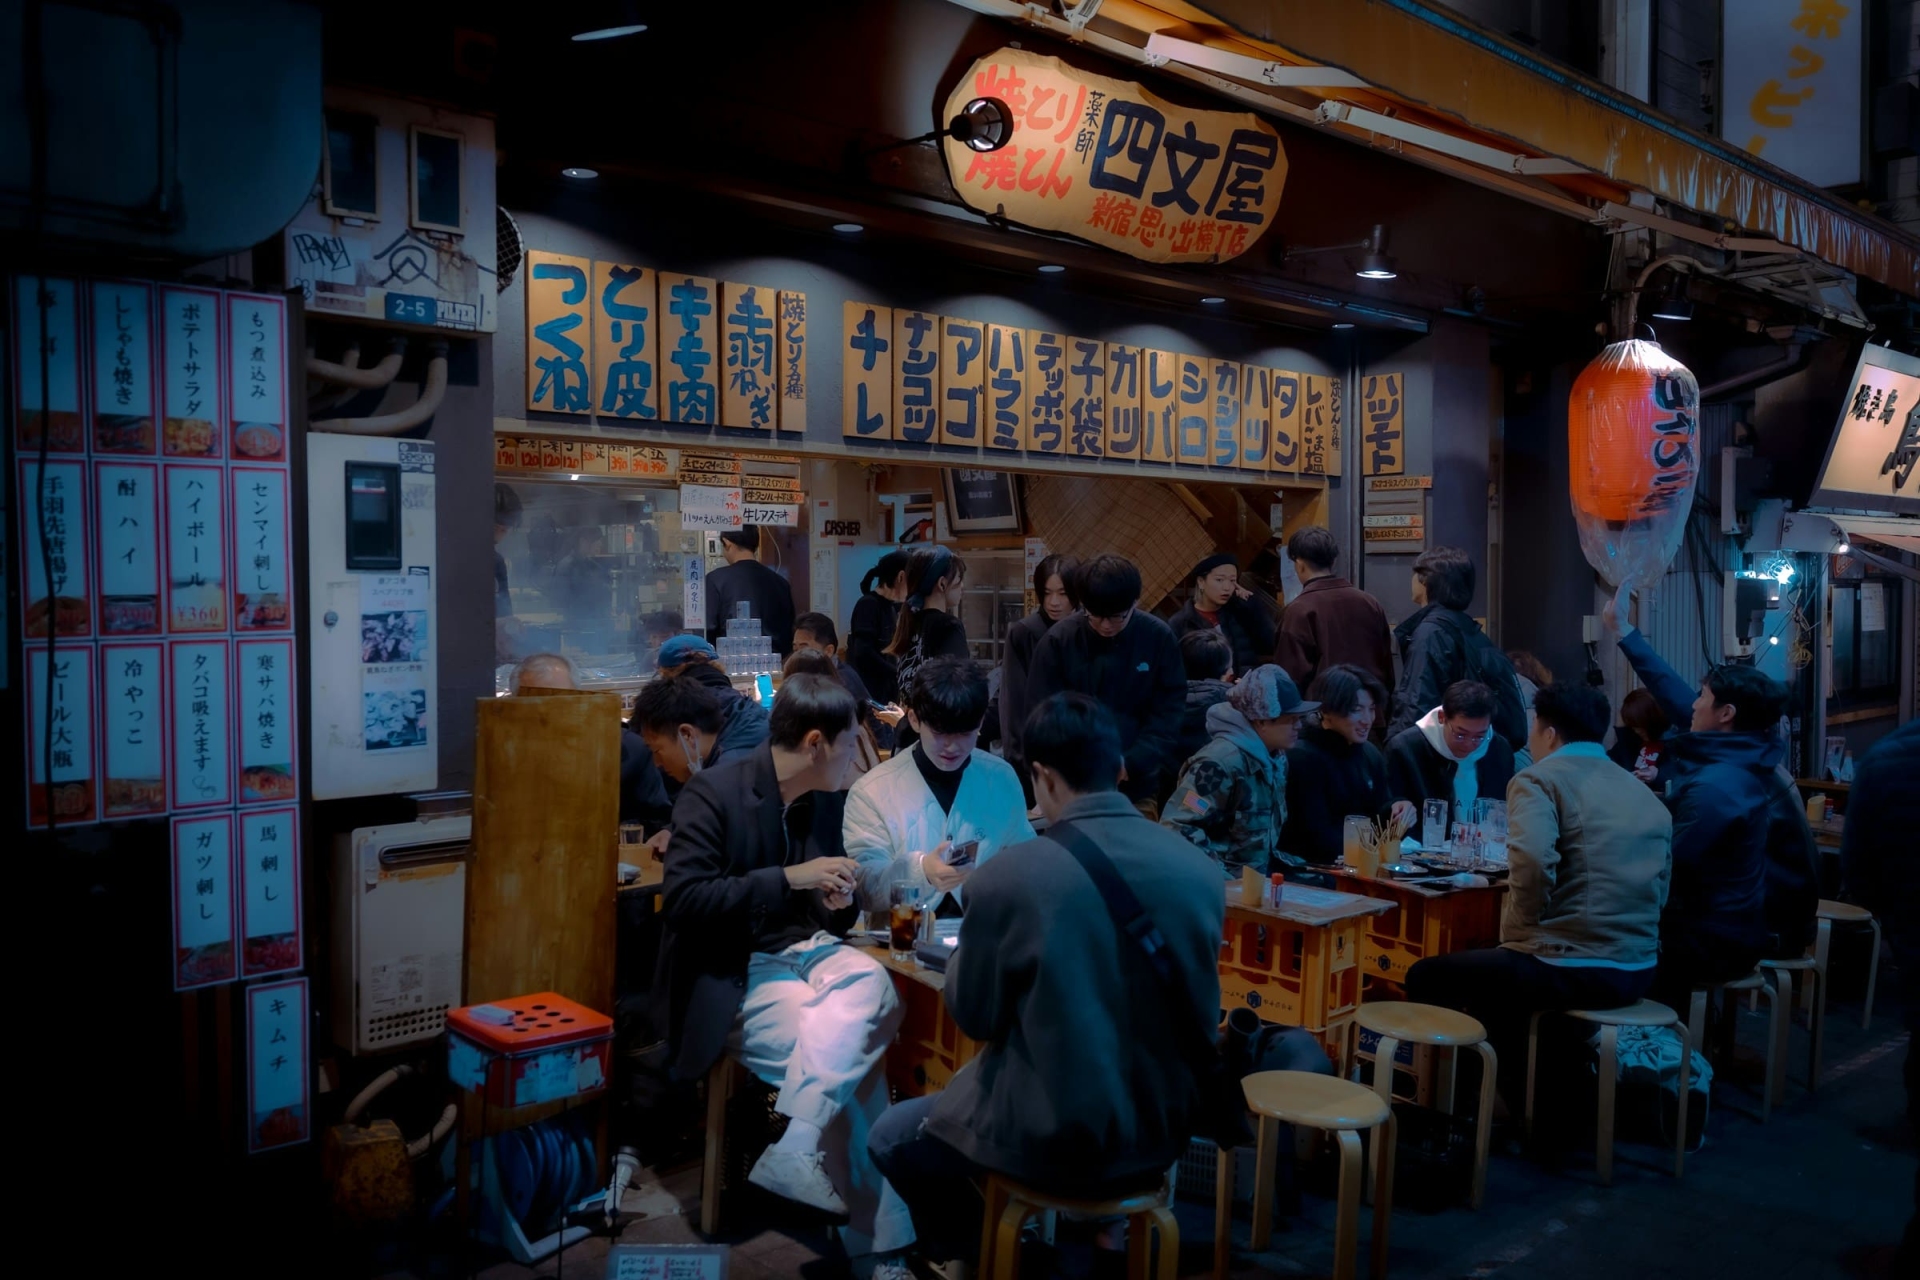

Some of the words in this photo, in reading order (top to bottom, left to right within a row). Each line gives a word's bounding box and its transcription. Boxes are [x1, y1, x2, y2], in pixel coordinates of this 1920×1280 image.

[975, 64, 1087, 143] 焼とり
[1075, 90, 1105, 164] 薬師
[964, 145, 1073, 200] 焼とん
[1089, 98, 1279, 225] 四文屋
[113, 295, 134, 405] ししゃも焼き
[181, 303, 202, 416] ポテトサラダ
[250, 311, 267, 400] もつ煮込み
[395, 300, 426, 317] 2-5
[533, 263, 592, 412] つくね
[601, 265, 656, 418] とり皮
[850, 309, 888, 434] チレ
[902, 313, 937, 442] ナンコツ
[946, 323, 984, 438] アゴ
[989, 328, 1024, 450] ハラミ
[1032, 333, 1065, 451] テッポウ
[1070, 340, 1104, 455] 子袋
[1110, 345, 1142, 454] ガツ
[1145, 351, 1176, 459] レバ
[1180, 361, 1208, 457] シロ
[1215, 361, 1239, 466] カシラ
[1245, 366, 1269, 463] ハツ
[1273, 376, 1299, 467] タン
[1364, 375, 1401, 474] ハツモト
[117, 478, 138, 564] 酎ハイ
[185, 479, 206, 586] ハイボール
[250, 482, 271, 591] センマイ刺し
[177, 606, 219, 621] ¥360
[123, 659, 144, 745] 冷やっこ
[191, 653, 212, 770] タバコ吸えます
[256, 653, 276, 750] 寒サバ焼き
[195, 830, 214, 920] ガツ刺し
[259, 825, 279, 902] 馬刺し
[268, 999, 288, 1072] キムチ
